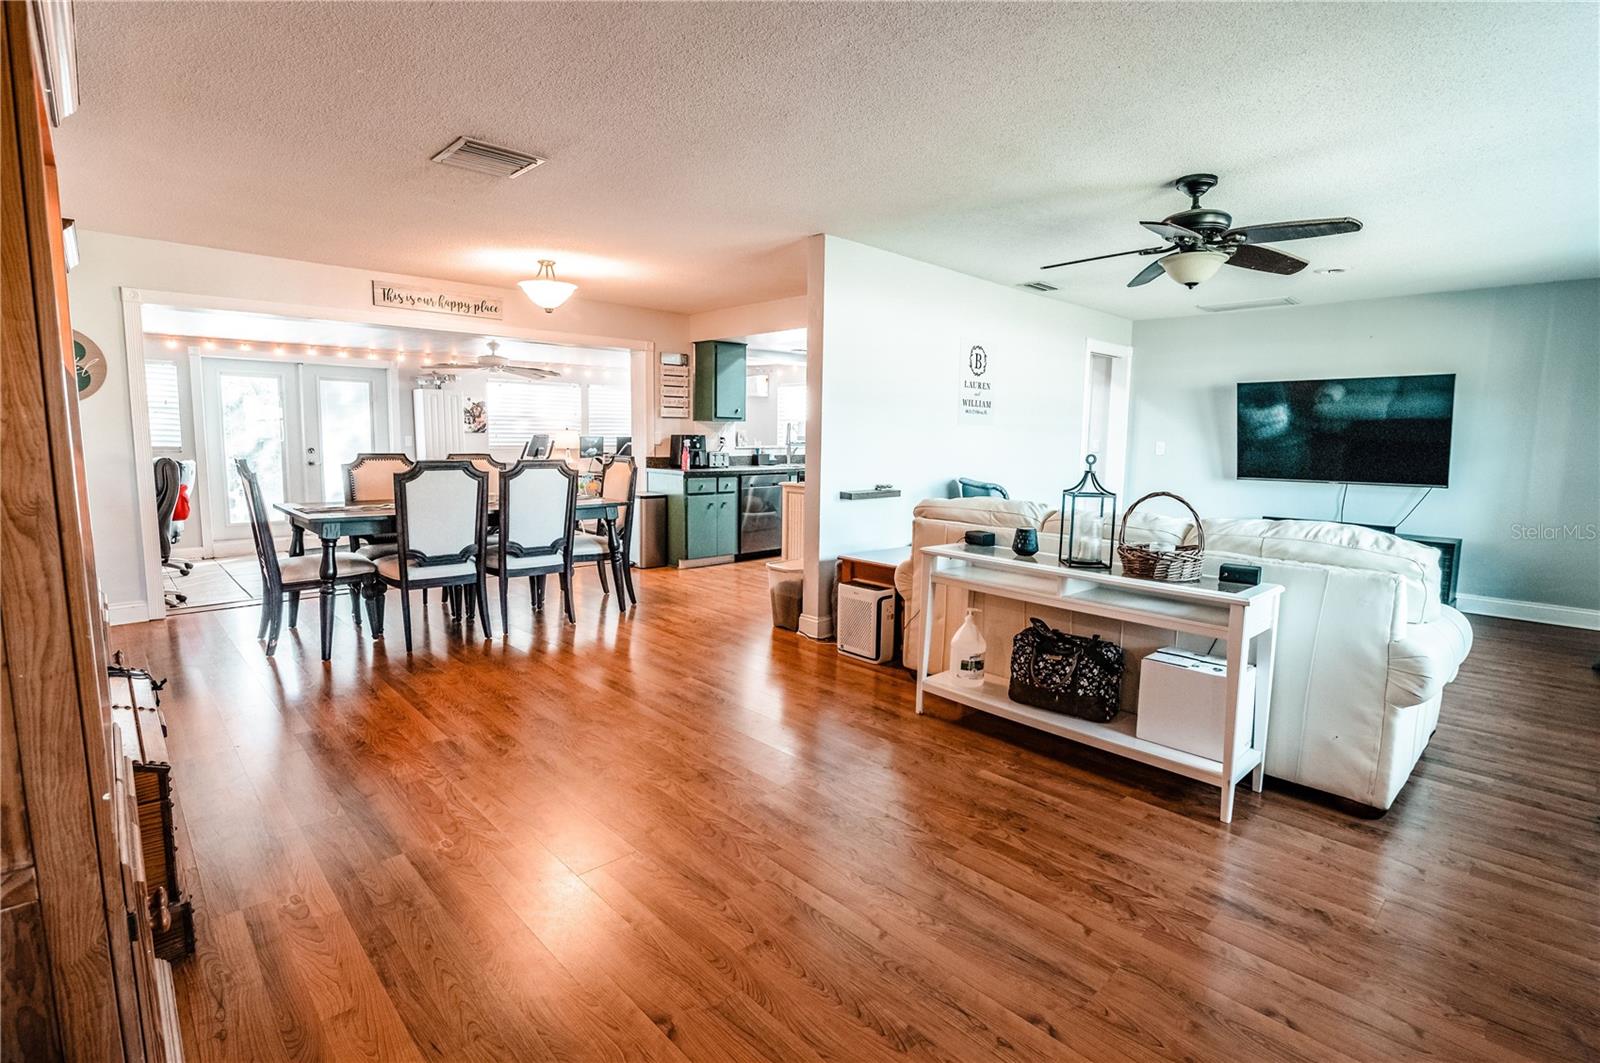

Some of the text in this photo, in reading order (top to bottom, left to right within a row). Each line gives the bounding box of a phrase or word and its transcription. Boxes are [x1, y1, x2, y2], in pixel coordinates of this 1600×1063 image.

[380, 287, 499, 315] This is our happy place
[974, 353, 983, 369] B
[964, 380, 991, 390] LAUREN
[962, 398, 992, 408] WILLIAM
